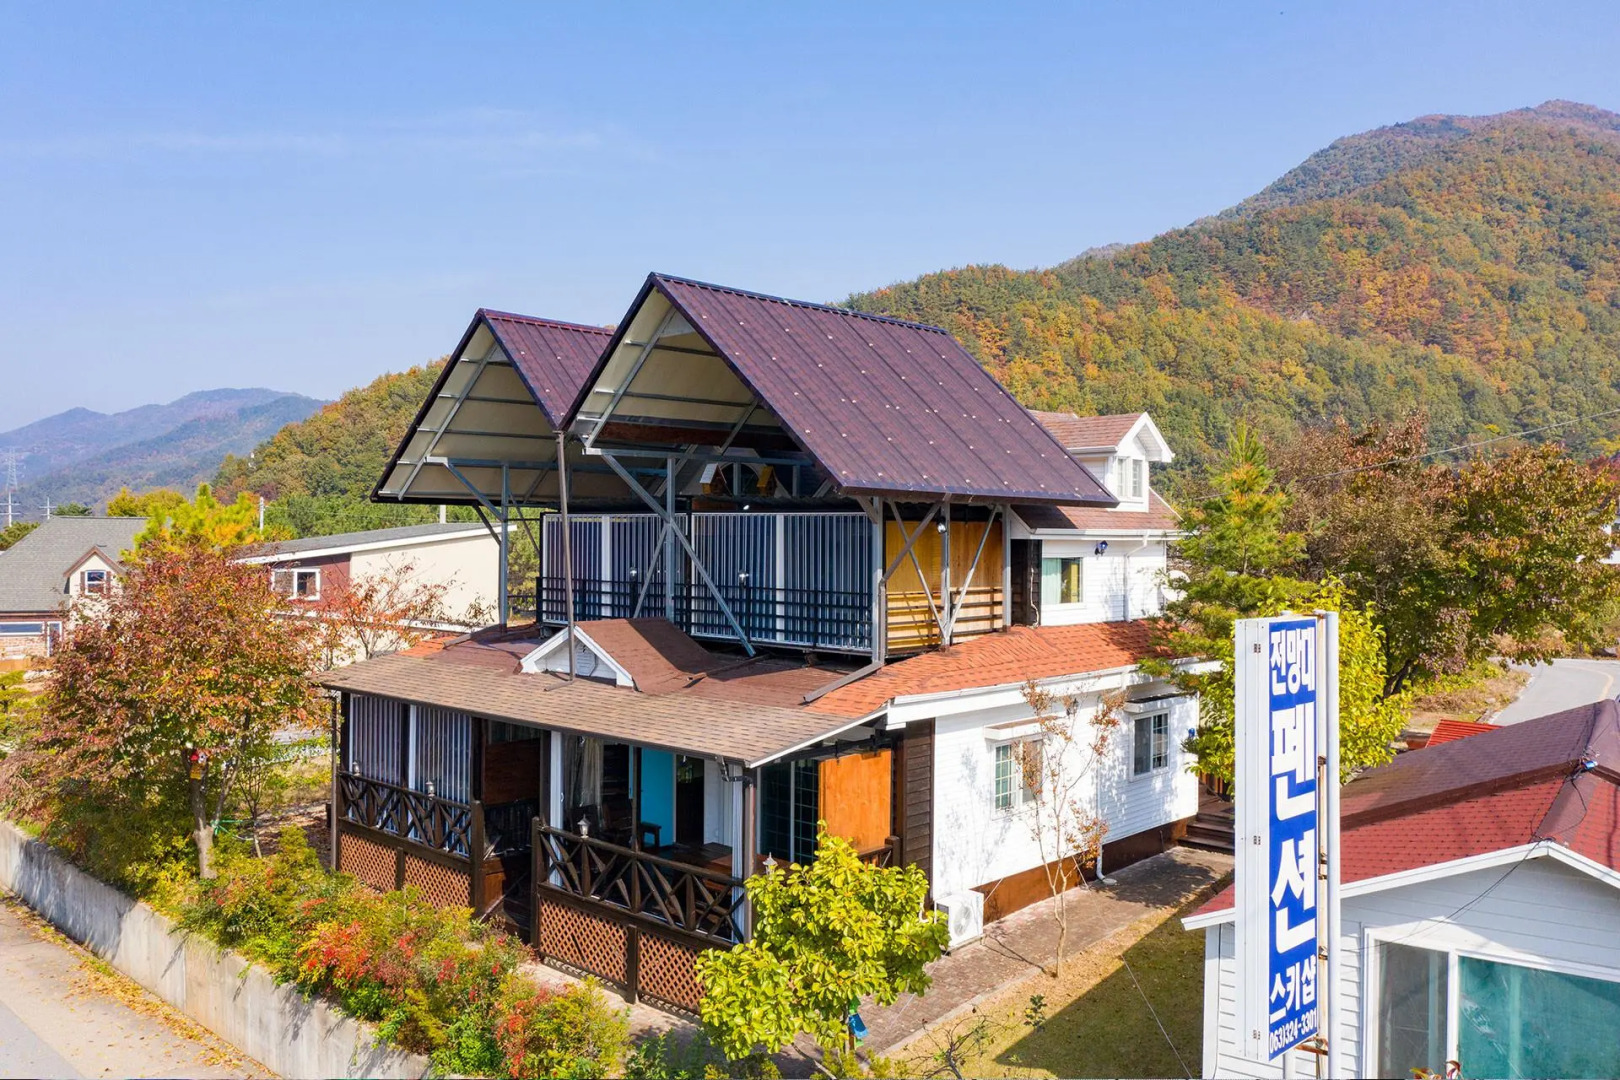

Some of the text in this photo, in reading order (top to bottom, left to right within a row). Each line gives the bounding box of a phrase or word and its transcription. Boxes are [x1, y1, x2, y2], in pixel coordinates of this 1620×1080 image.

[1270, 626, 1315, 696] 전망대
[1271, 701, 1316, 954] 펜션
[1269, 954, 1316, 1024] 스키샵
